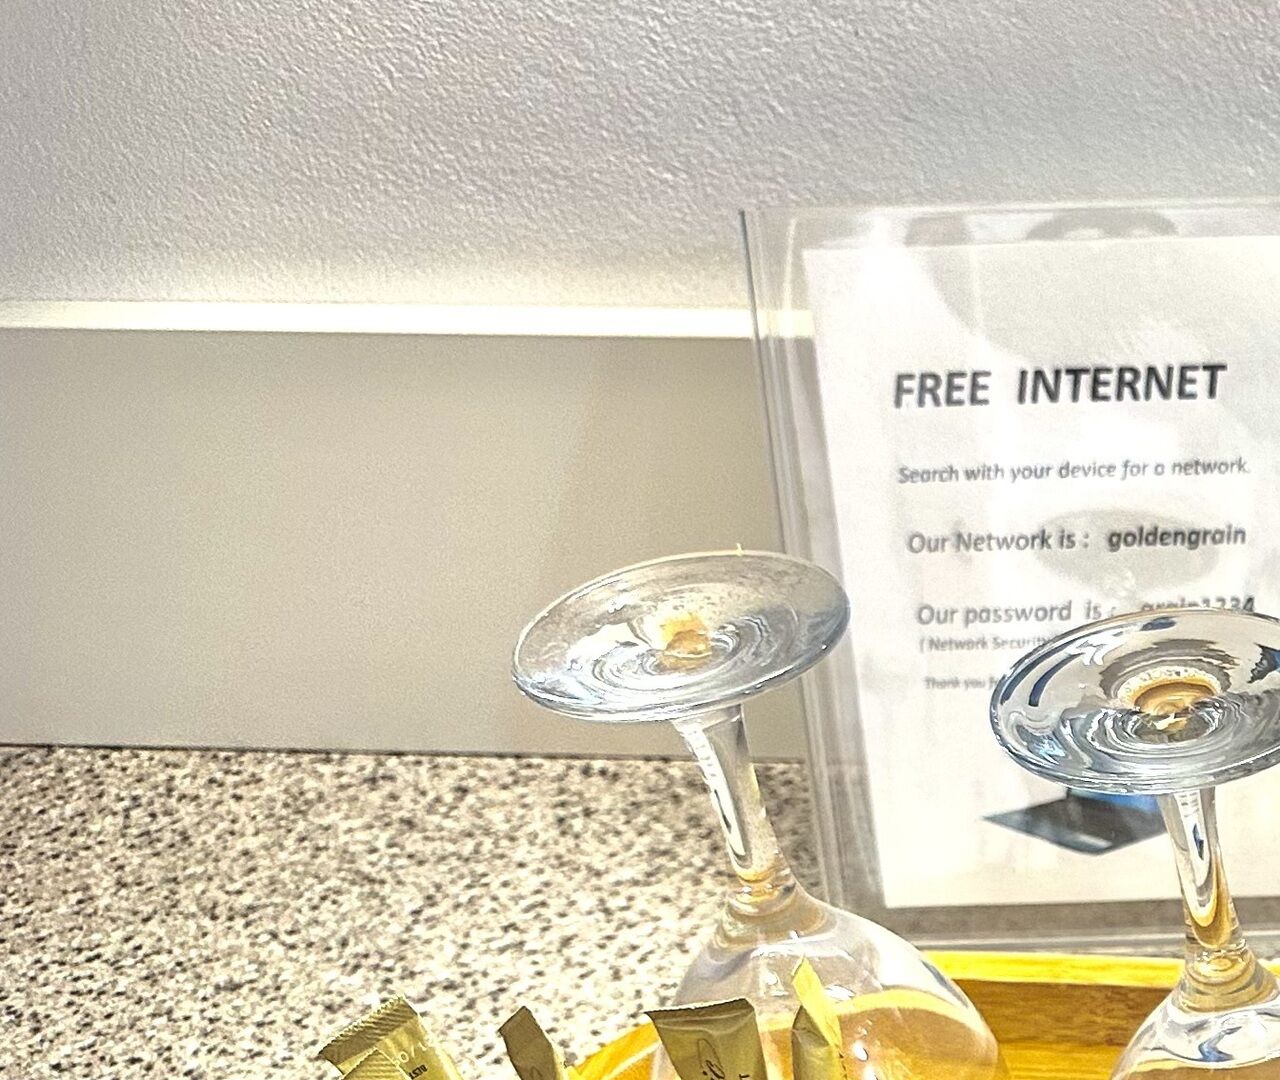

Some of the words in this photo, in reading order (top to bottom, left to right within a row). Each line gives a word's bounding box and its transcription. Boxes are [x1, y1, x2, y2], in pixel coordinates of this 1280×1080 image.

[894, 369, 992, 409] FREE
[1017, 364, 1229, 405] INTERNET
[899, 465, 959, 484] Search
[964, 461, 1004, 482] with
[1009, 465, 1052, 483] your
[1058, 460, 1116, 480] device
[1121, 459, 1149, 481] for
[1154, 462, 1165, 477] a
[1171, 457, 1251, 477] network.
[908, 532, 949, 554] Our
[956, 529, 1052, 552] Network
[1058, 528, 1076, 550] is
[1108, 525, 1247, 552] goldengrain
[917, 603, 958, 625] Our
[963, 600, 1073, 628] password
[1084, 599, 1102, 620] is
